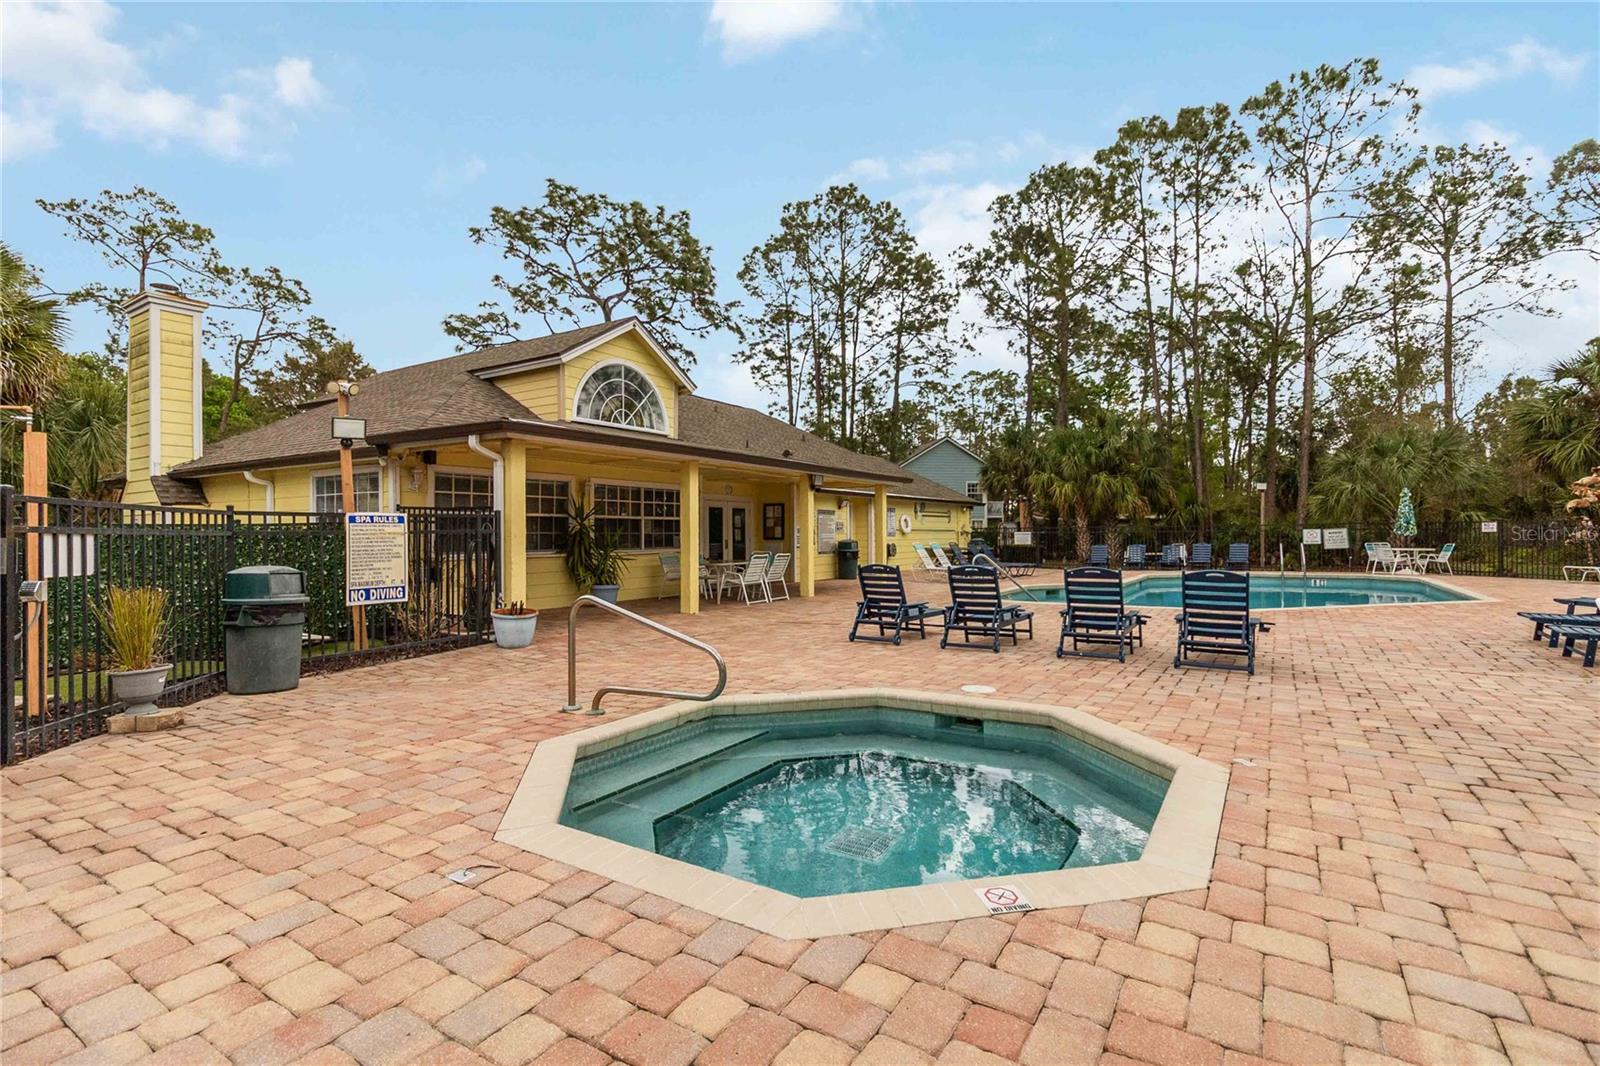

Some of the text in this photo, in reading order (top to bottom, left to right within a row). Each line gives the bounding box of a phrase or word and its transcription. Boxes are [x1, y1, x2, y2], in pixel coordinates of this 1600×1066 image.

[355, 515, 399, 523] SPA RULES
[351, 587, 403, 602] NO DIVING
[1004, 903, 1032, 912] DIVING
